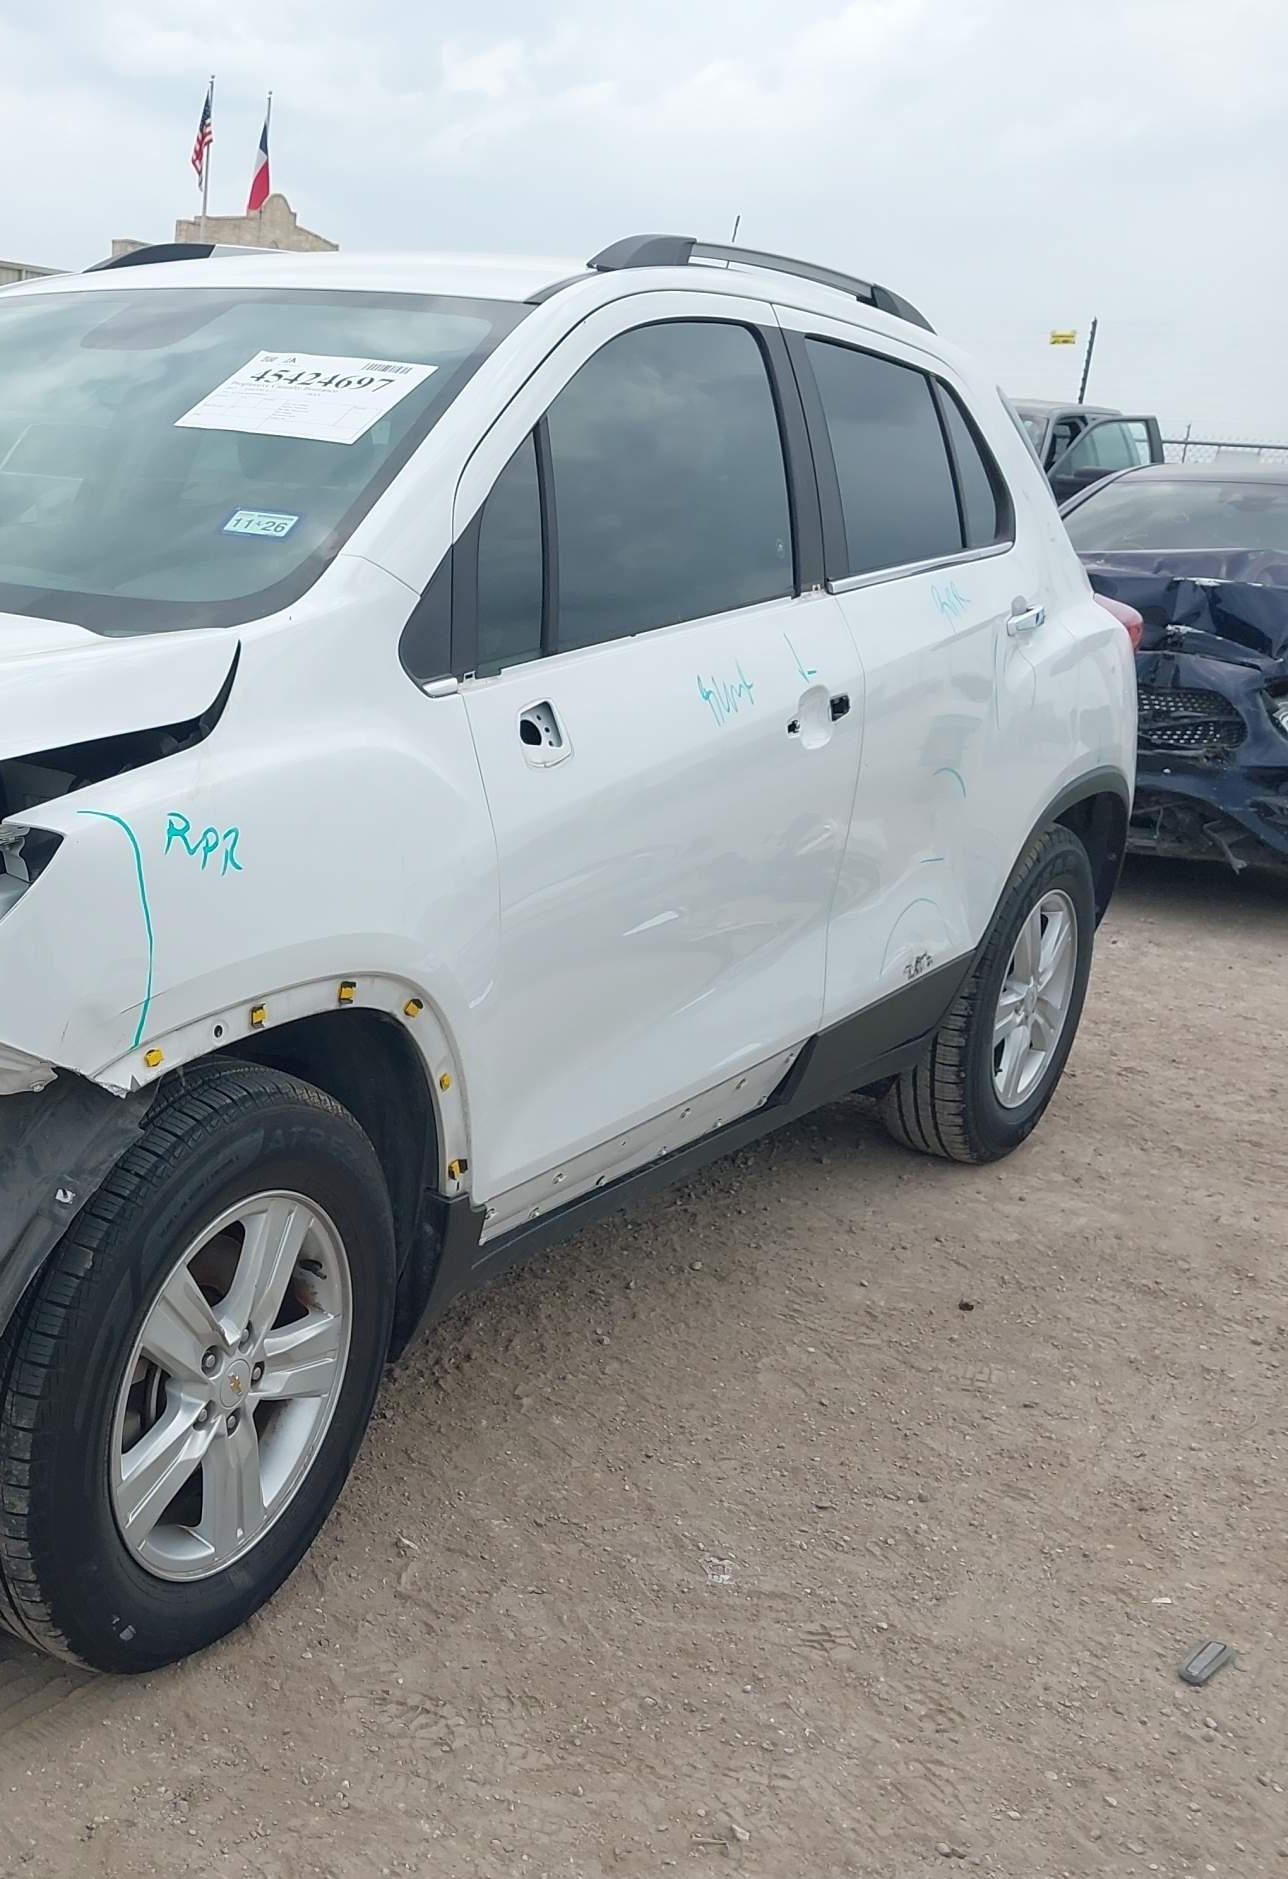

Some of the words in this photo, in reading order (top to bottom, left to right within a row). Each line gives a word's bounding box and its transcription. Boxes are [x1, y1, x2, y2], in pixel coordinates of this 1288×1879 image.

[250, 369, 395, 392] 45424697
[233, 518, 254, 529] 11
[260, 520, 288, 533] 26
